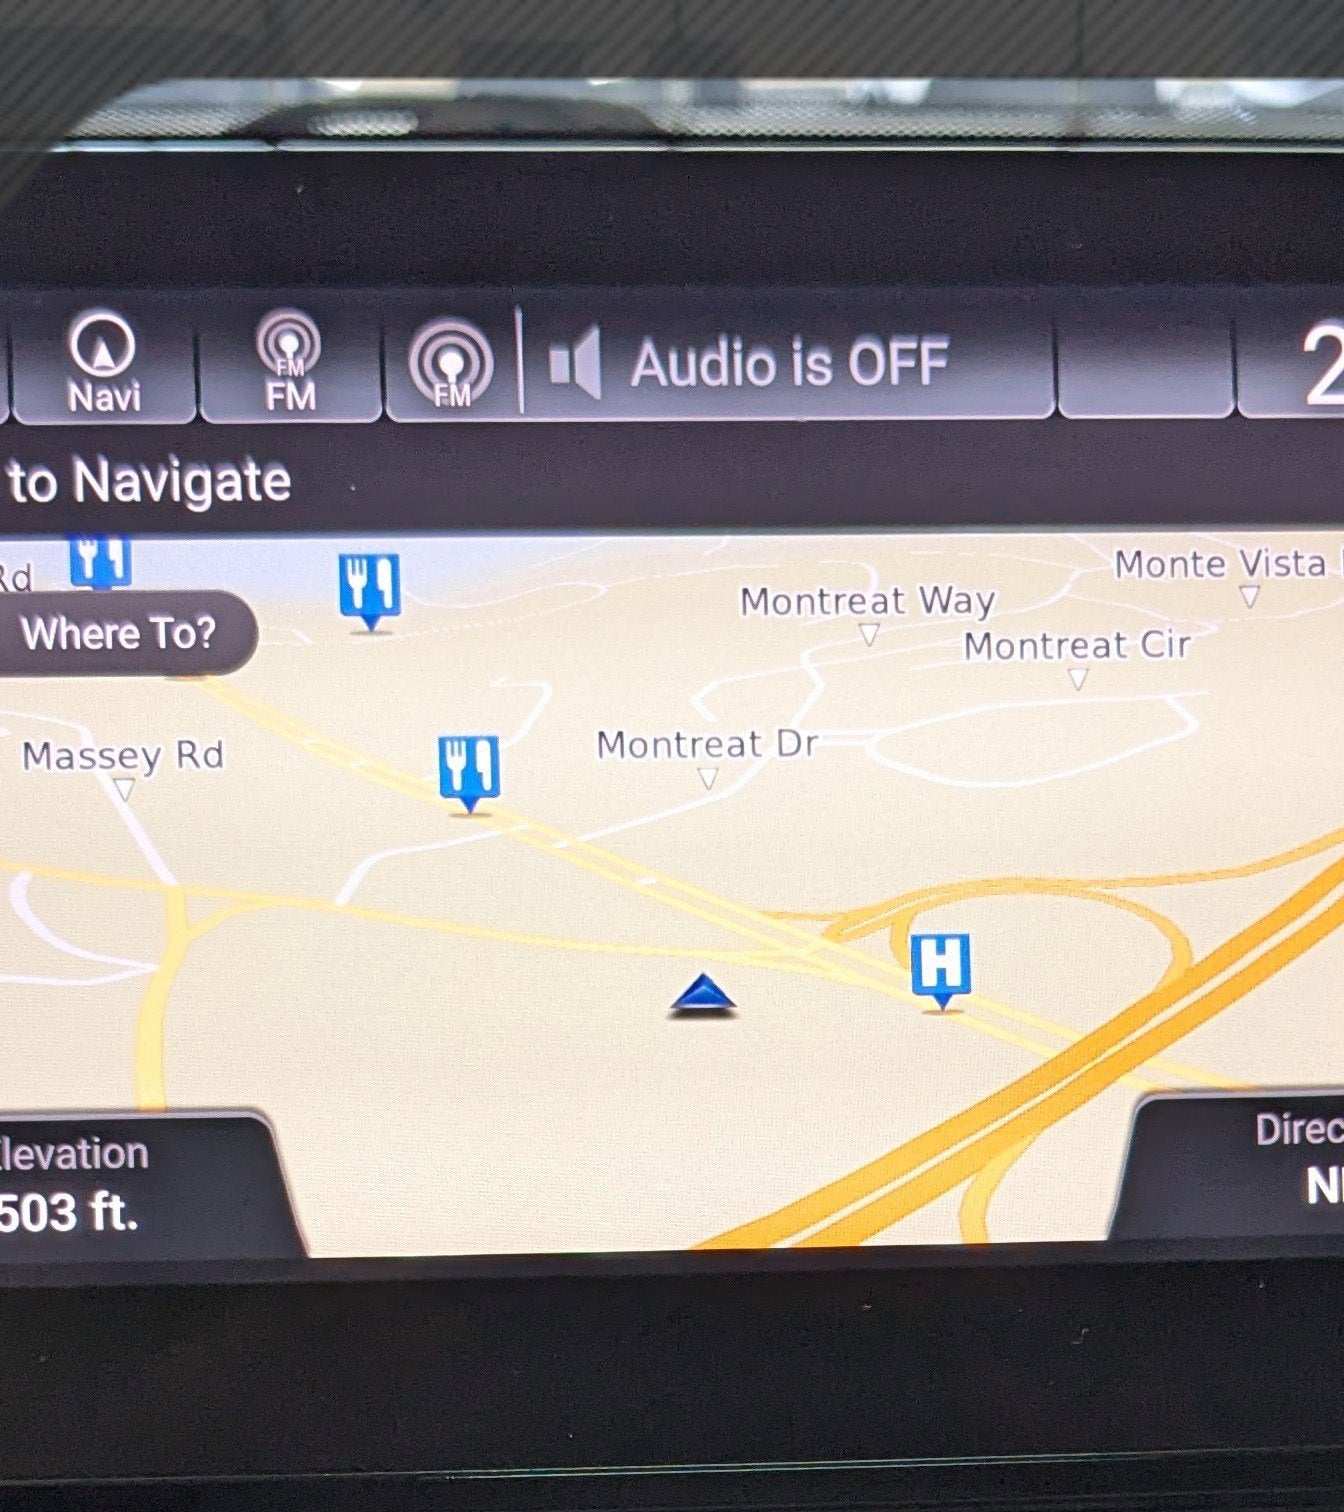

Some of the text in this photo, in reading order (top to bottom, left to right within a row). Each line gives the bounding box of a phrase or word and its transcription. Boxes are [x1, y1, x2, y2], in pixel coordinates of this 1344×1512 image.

[276, 358, 305, 378] FM
[630, 337, 949, 389] Audio is OFF
[69, 383, 141, 413] Navi
[266, 381, 317, 411] FM
[434, 384, 471, 407] FM
[9, 463, 57, 504] to
[72, 456, 291, 513] Navigate
[1115, 549, 1226, 579] Monte
[1238, 548, 1327, 578] Vista
[740, 586, 995, 621] Montreat Way
[22, 617, 215, 651] Where To?
[964, 630, 1192, 661] Montreat Cir
[22, 741, 223, 777] Massey Rd
[597, 729, 818, 759] Montreat Dr
[922, 940, 960, 988] H
[91, 1193, 138, 1231] ft.
